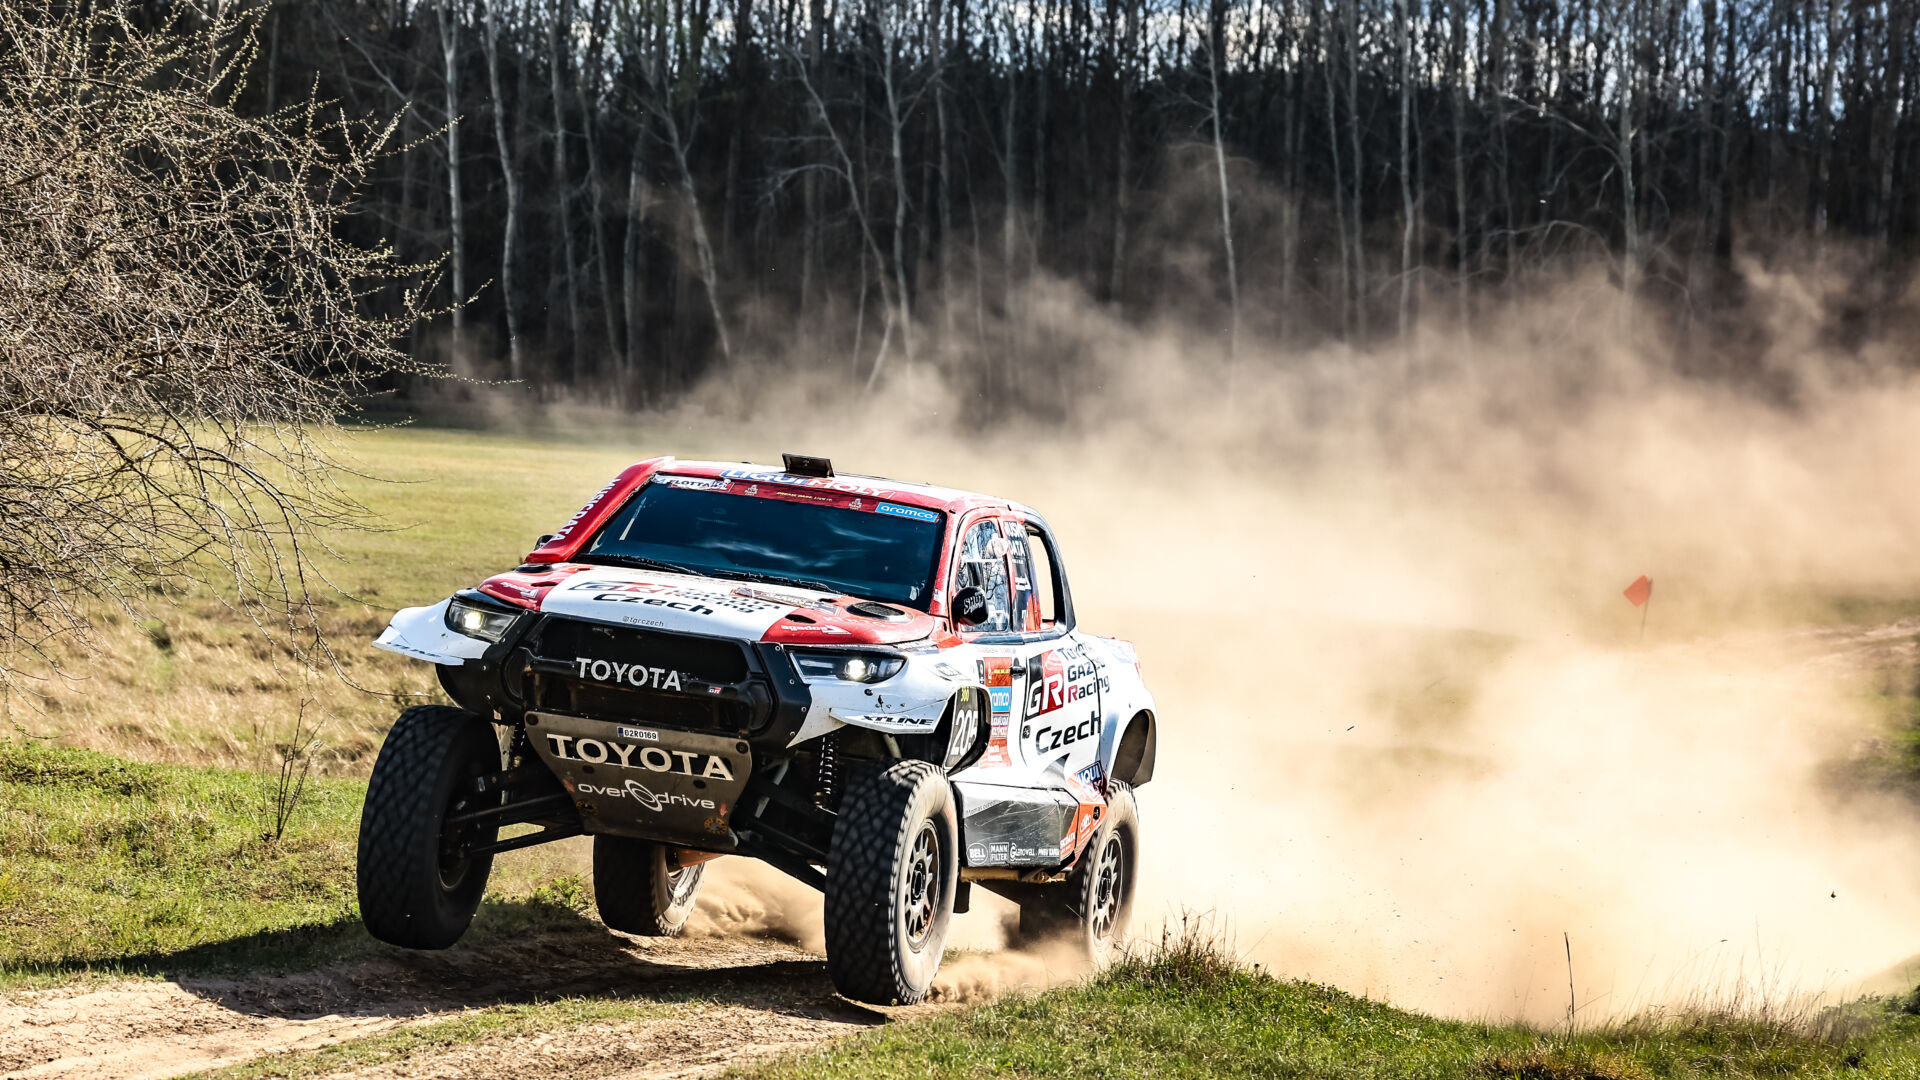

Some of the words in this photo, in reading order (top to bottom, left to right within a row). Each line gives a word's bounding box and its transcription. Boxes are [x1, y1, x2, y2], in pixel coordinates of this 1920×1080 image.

[724, 469, 807, 485] LIQUI
[809, 478, 890, 498] MOLY
[548, 478, 622, 542] MUSICDATA
[880, 504, 934, 519] aramco
[592, 593, 715, 615] Czech
[576, 657, 682, 692] TOYOTA
[1026, 673, 1063, 717] GR
[1067, 675, 1111, 704] Racing
[1035, 710, 1102, 756] Czech
[546, 733, 735, 781] TOYOTA
[969, 848, 986, 858] BELL
[990, 844, 1008, 853] MANN
[990, 853, 1008, 861] FILTER
